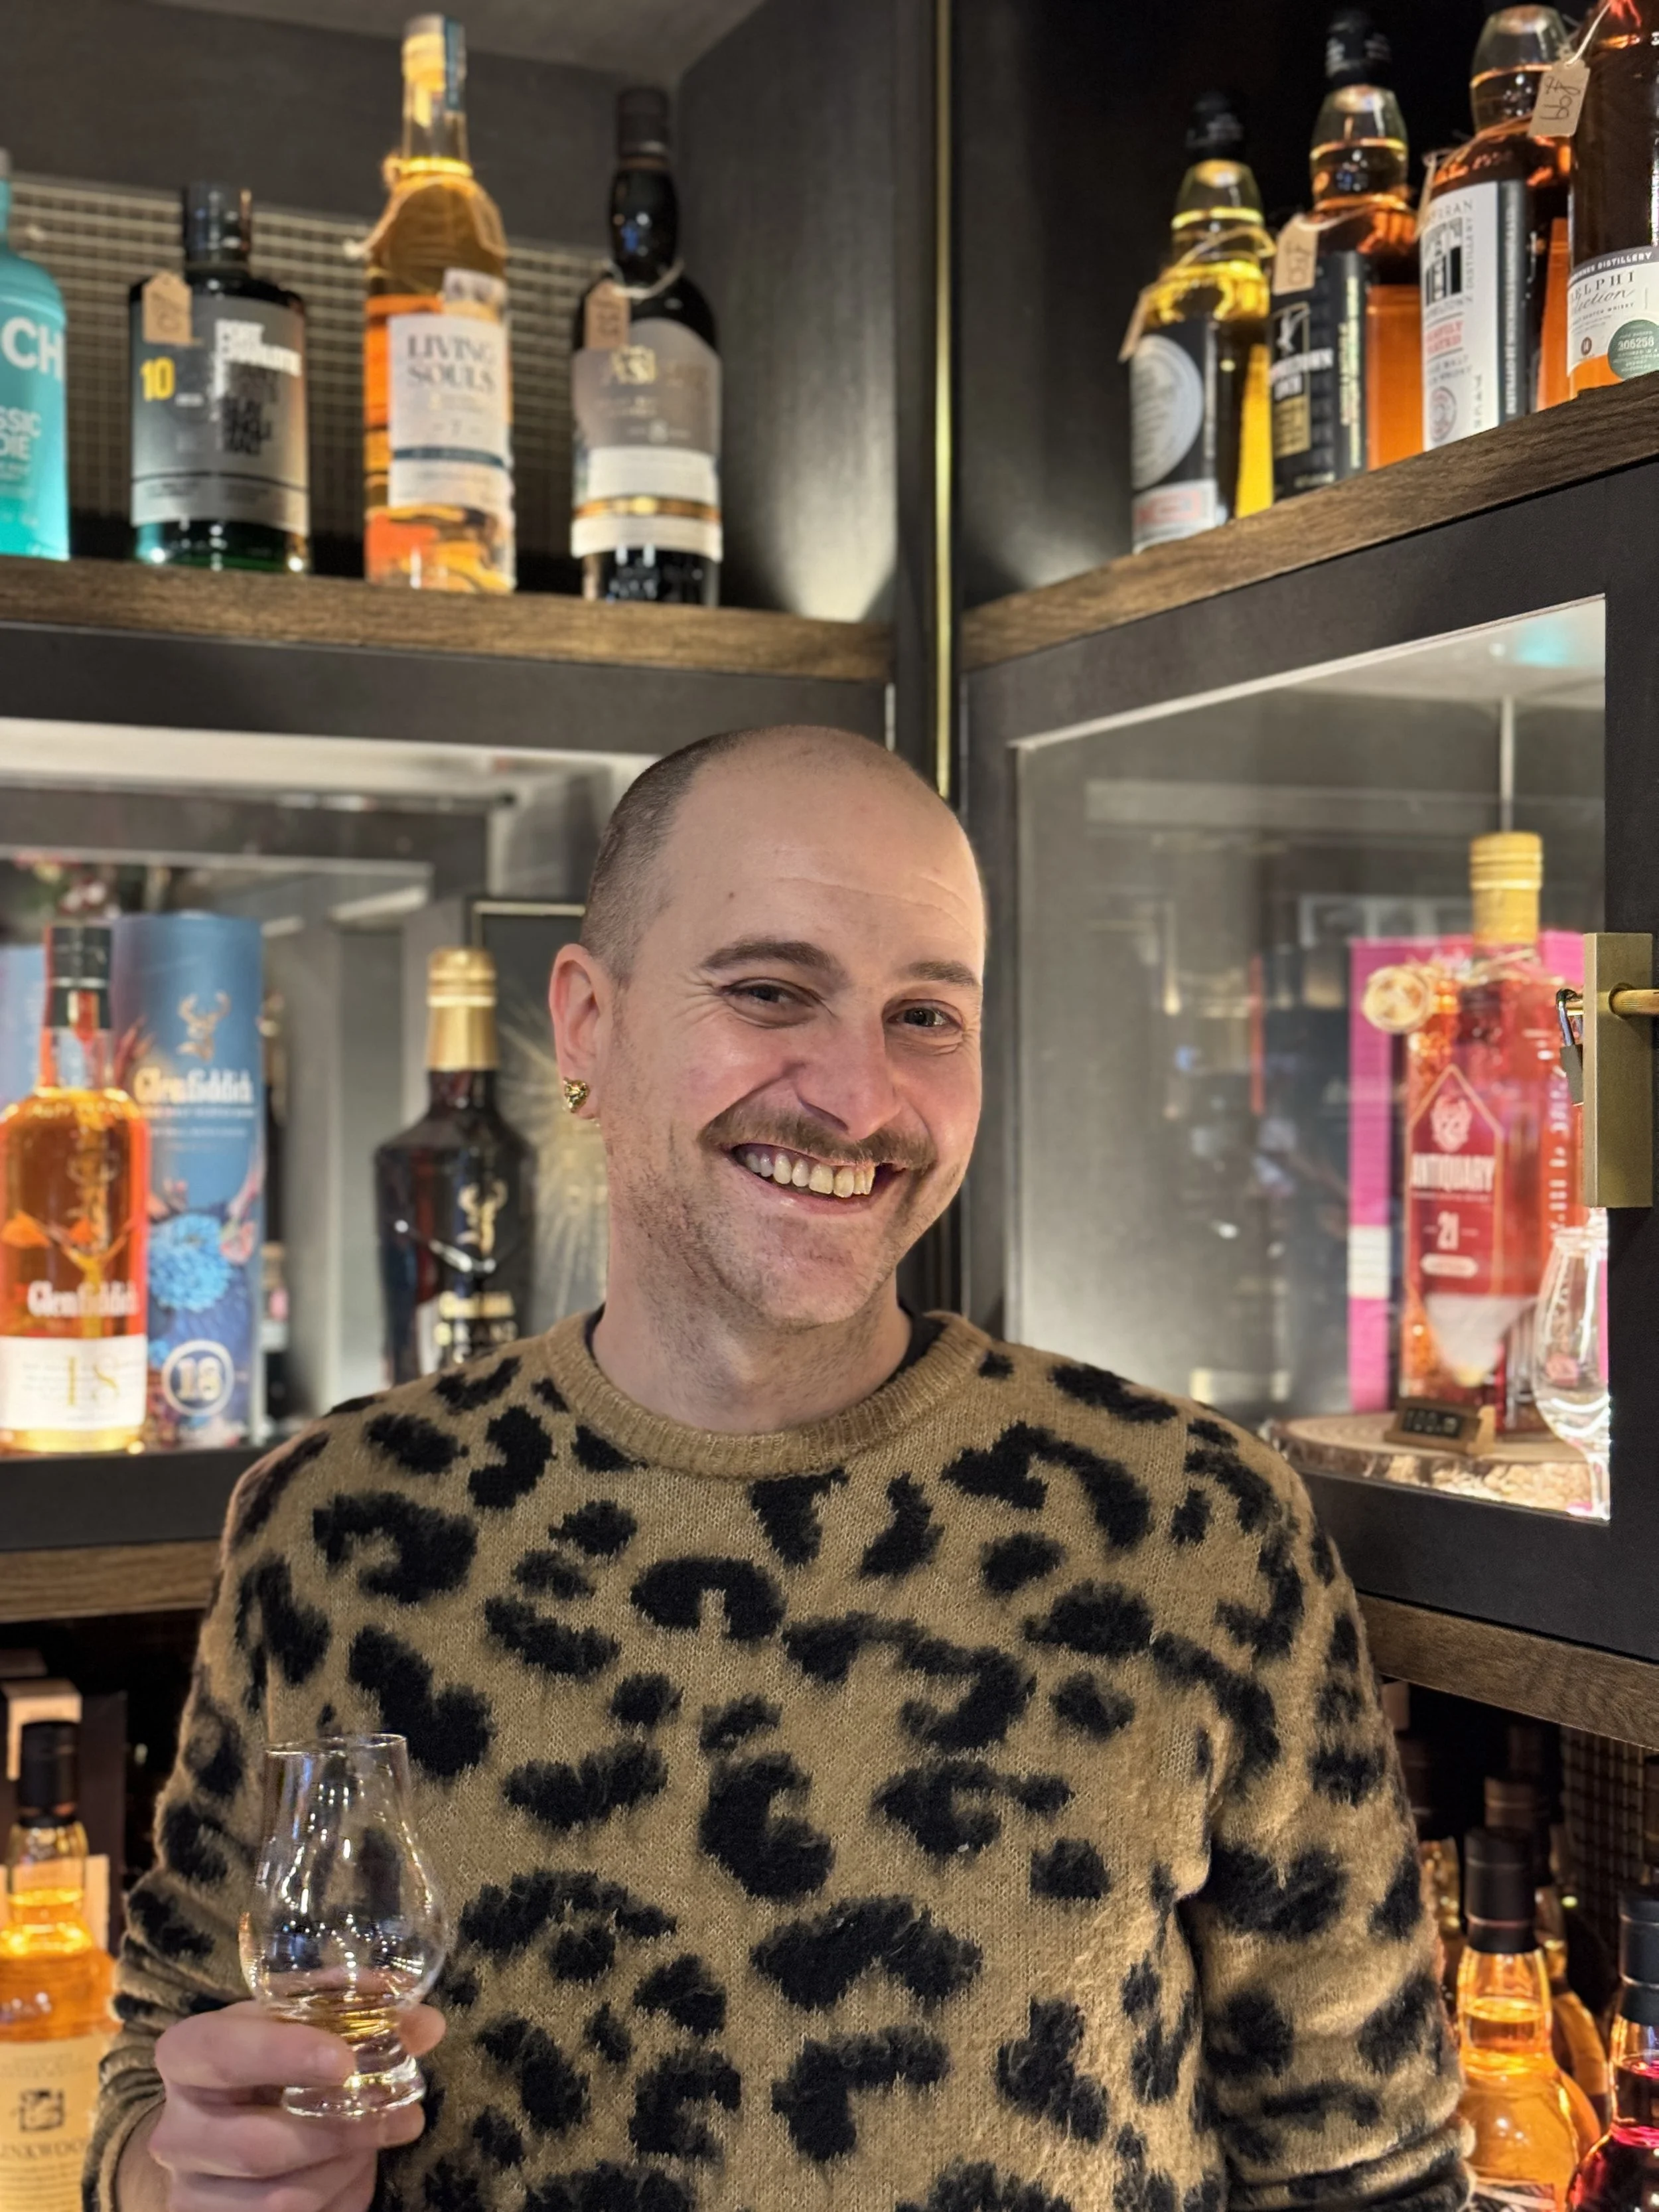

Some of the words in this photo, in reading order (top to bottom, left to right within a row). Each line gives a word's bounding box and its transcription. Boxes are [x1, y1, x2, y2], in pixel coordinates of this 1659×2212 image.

[1597, 252, 1652, 270] DISTILLERY
[407, 334, 496, 365] LIVING
[140, 356, 175, 402] 10
[407, 366, 496, 395] SOULS
[1437, 1211, 1459, 1250] 21
[177, 1356, 221, 1400] 18
